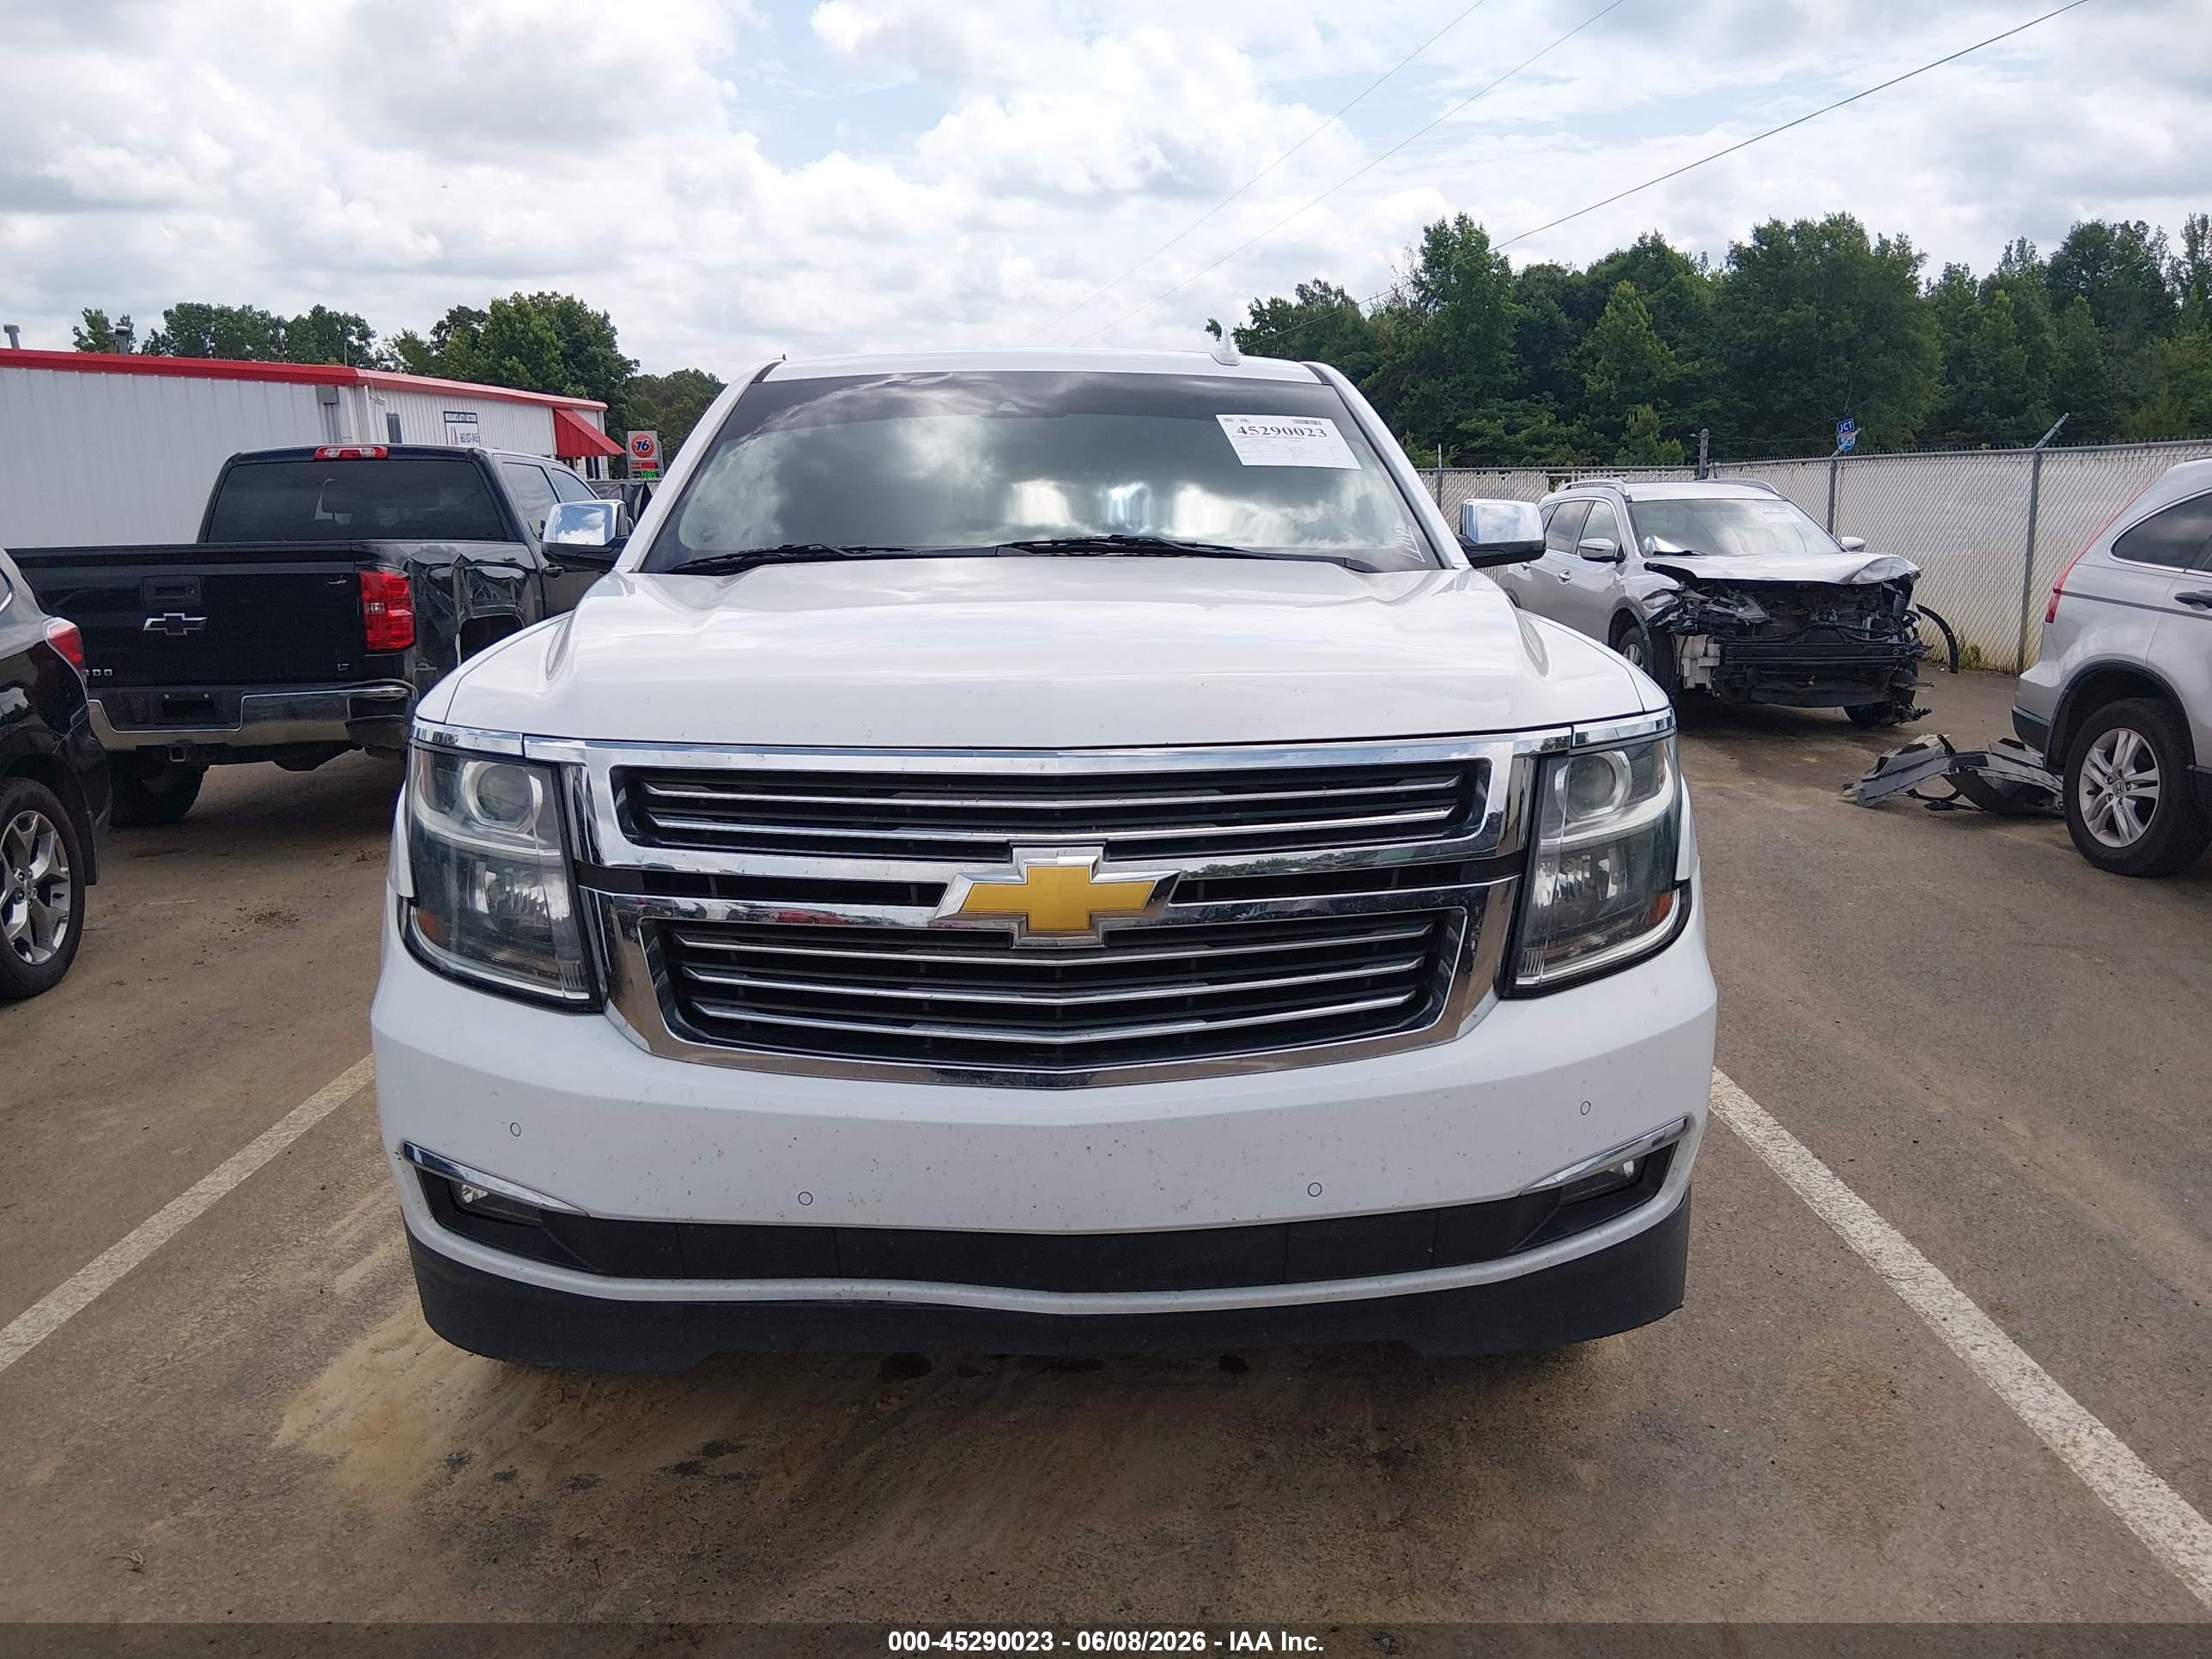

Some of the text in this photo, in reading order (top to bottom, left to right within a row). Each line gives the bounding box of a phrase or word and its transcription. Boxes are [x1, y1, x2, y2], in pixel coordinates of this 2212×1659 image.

[1237, 425, 1328, 438] 45290023
[1839, 421, 1852, 432] JCT
[635, 439, 650, 452] 76
